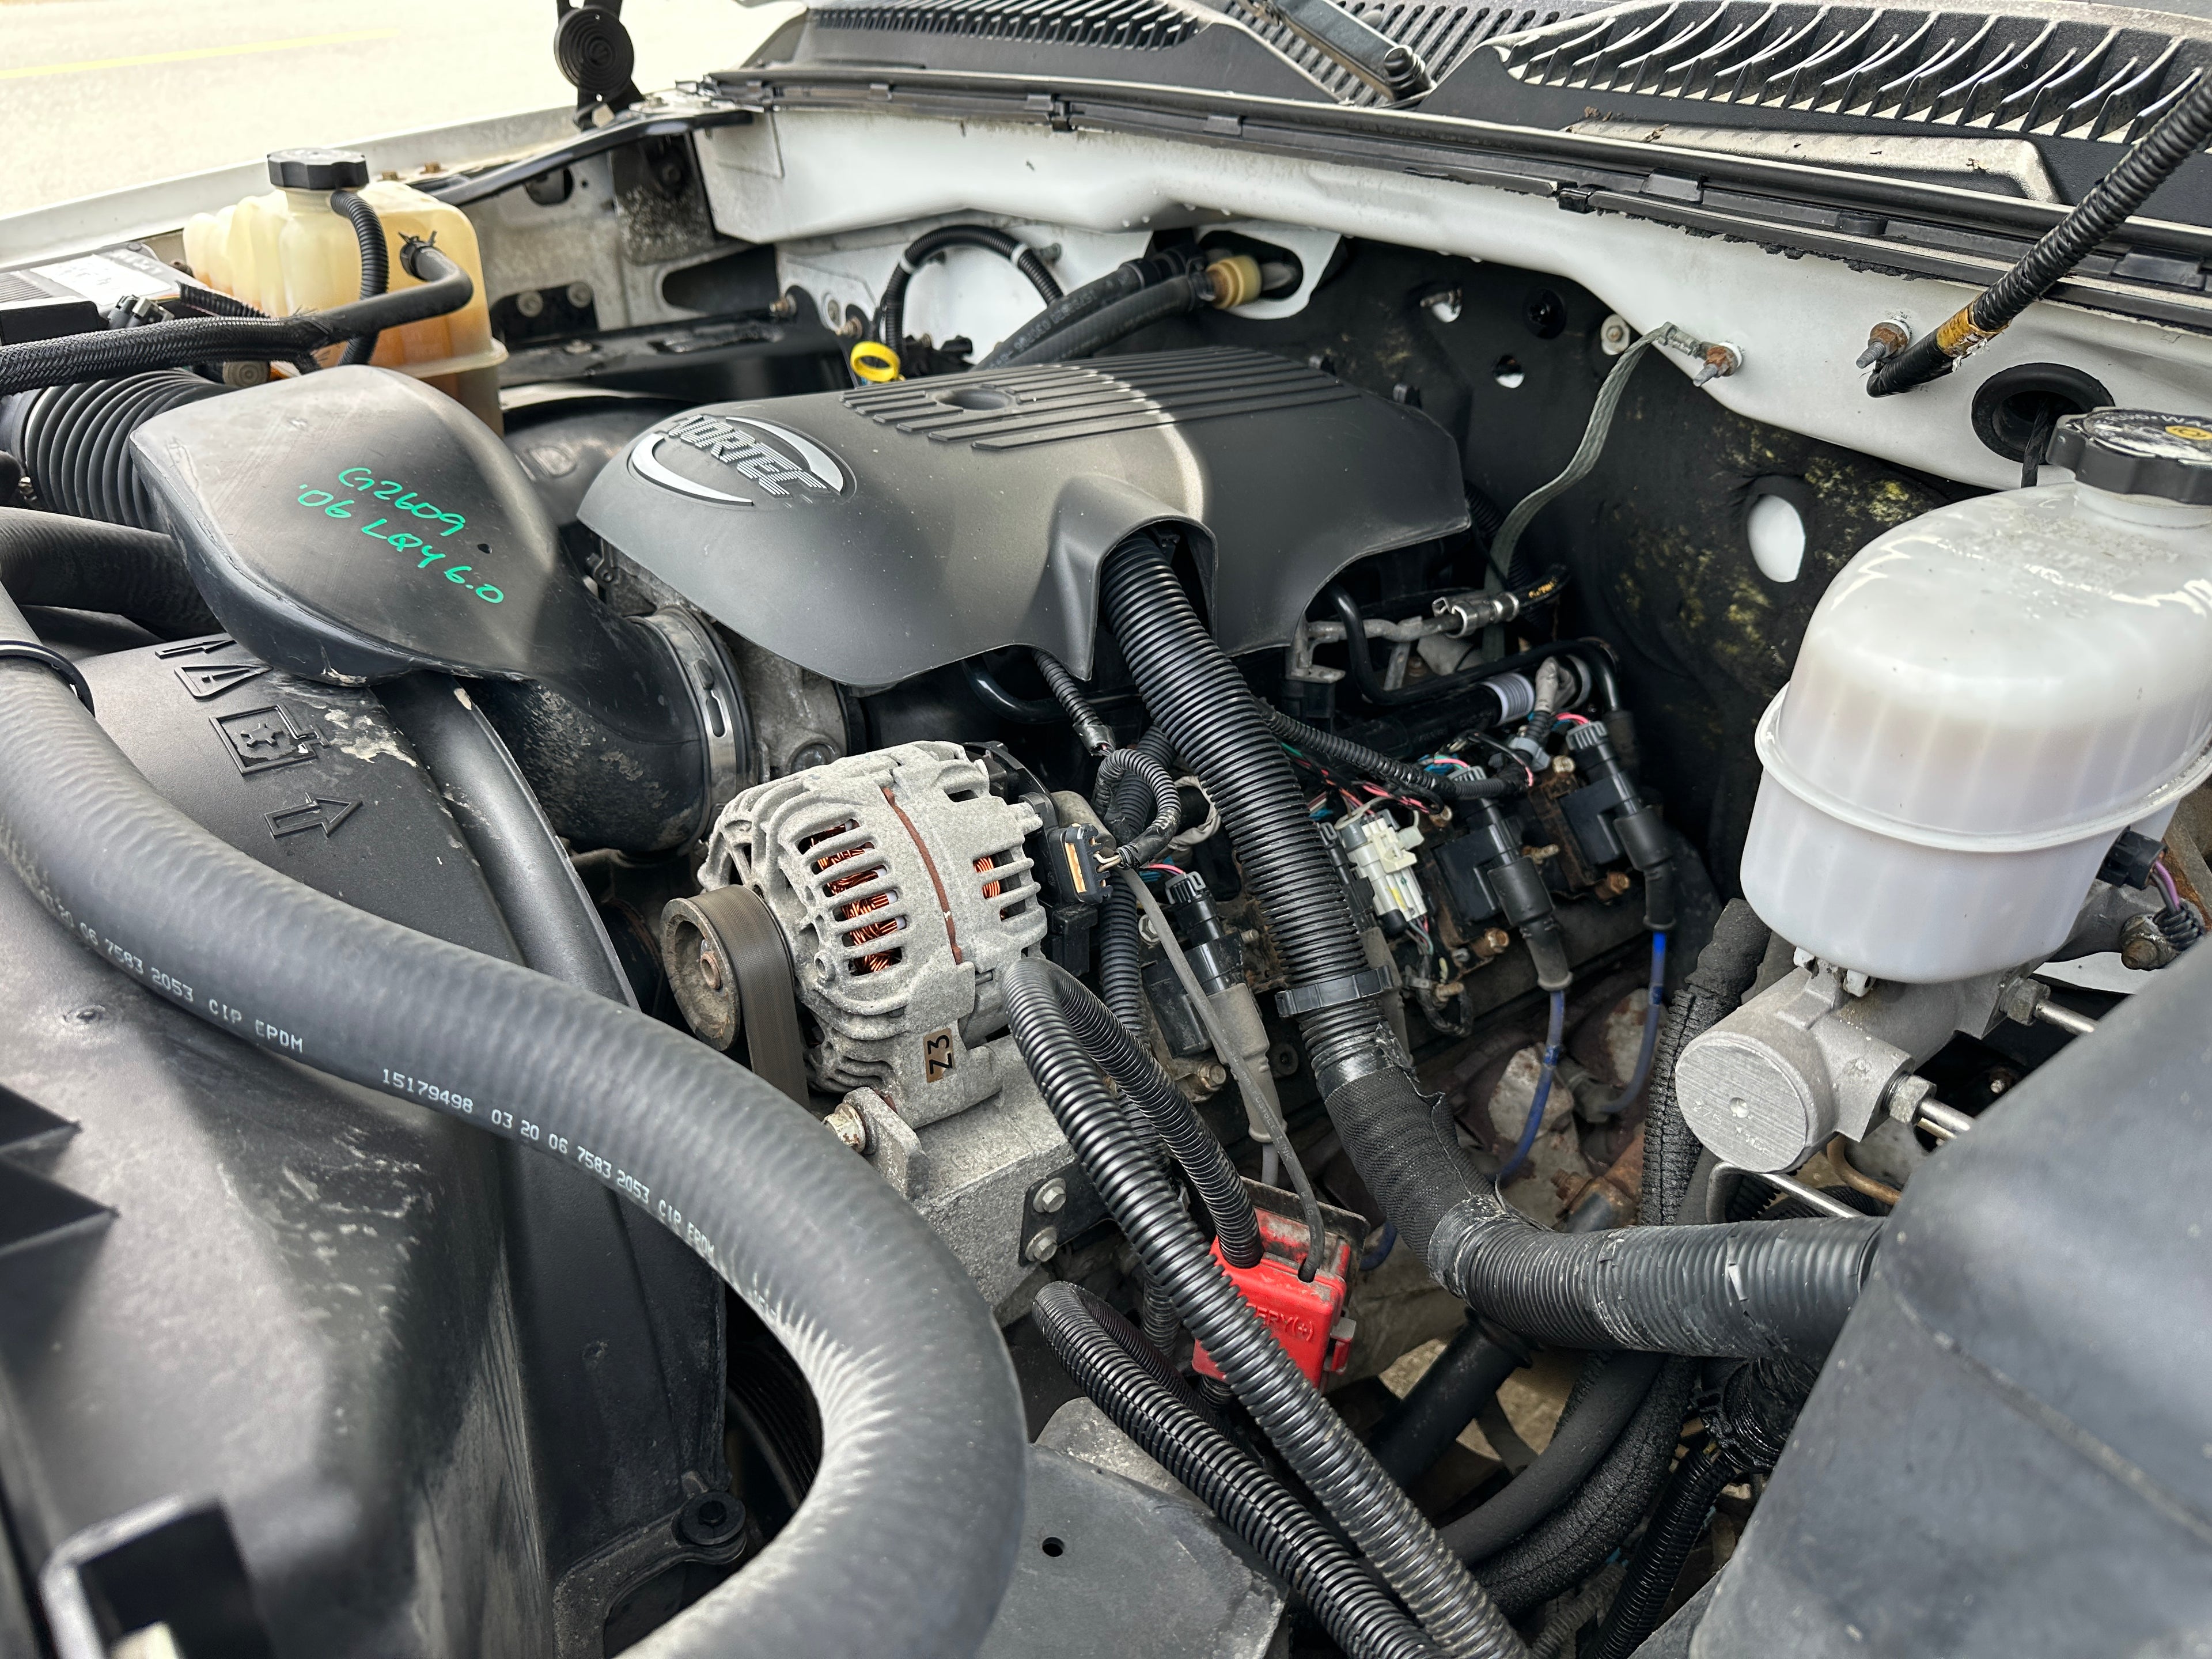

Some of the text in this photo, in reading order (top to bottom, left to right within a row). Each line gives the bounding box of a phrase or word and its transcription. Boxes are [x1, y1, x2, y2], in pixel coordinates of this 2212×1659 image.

[668, 414, 830, 500] VORTEC
[338, 467, 465, 536] G2609
[444, 566, 505, 604] 6.0
[104, 938, 143, 976] 7583
[150, 967, 194, 1002] 2053
[209, 998, 243, 1024] CIP
[255, 1019, 303, 1053] EPDM
[382, 1068, 474, 1114] 15179498
[491, 1109, 514, 1129] 03
[520, 1119, 540, 1141] 20
[548, 1133, 569, 1154] 06
[577, 1146, 612, 1179] 7583
[616, 1169, 650, 1204] 2053
[658, 1199, 682, 1225] CIP
